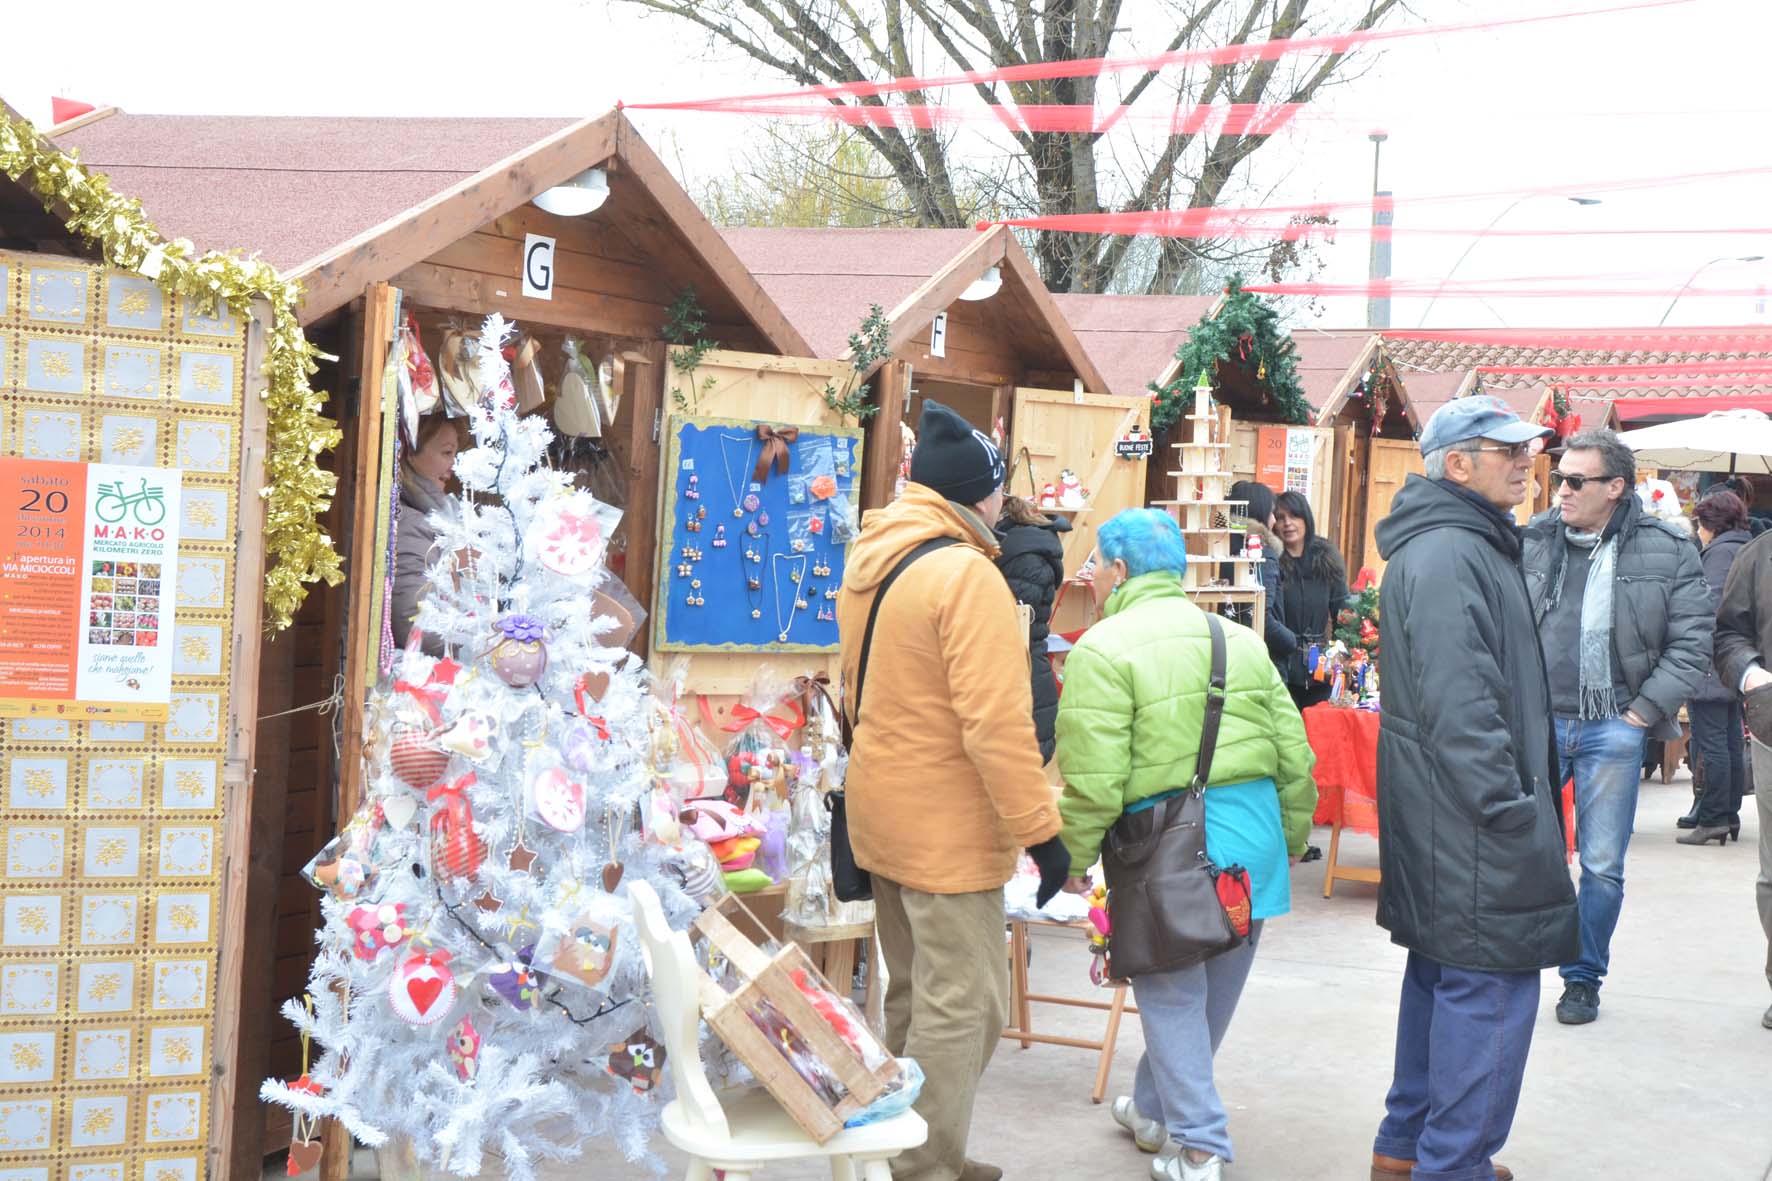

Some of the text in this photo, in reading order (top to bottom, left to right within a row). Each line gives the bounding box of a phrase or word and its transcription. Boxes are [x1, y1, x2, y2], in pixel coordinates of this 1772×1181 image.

[526, 241, 551, 291] G
[932, 315, 944, 350] F
[1268, 439, 1282, 449] 20
[19, 489, 69, 514] 20
[17, 525, 65, 539] 2014
[94, 539, 164, 549] MERCATO AGRICOLO
[93, 546, 139, 555] KILOMETRI
[20, 555, 64, 565] apertura
[66, 555, 76, 565] in
[3, 562, 18, 573] VIA
